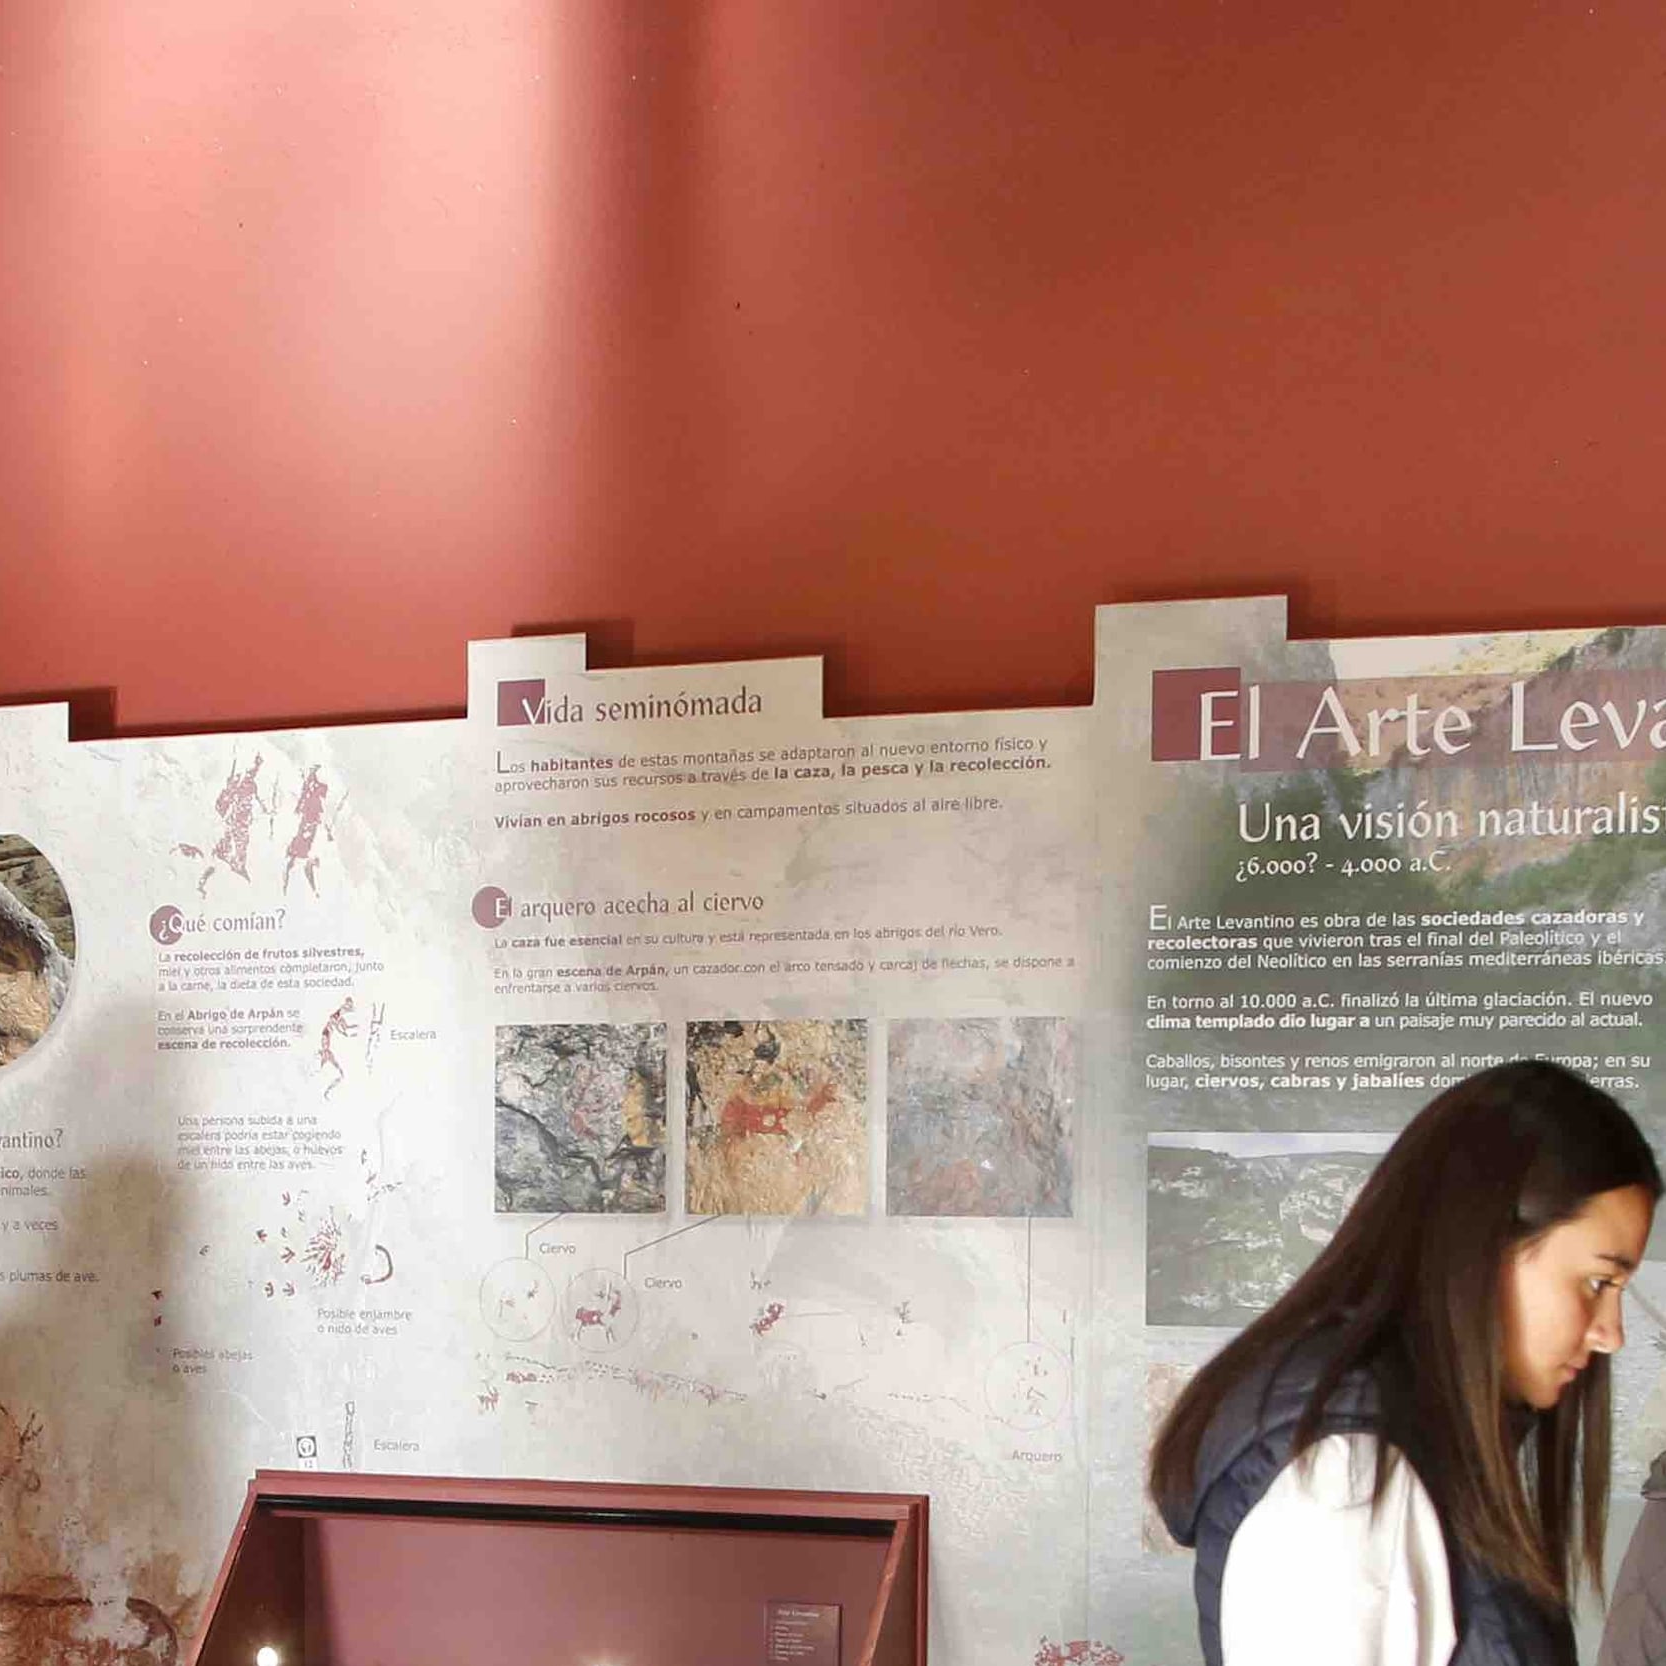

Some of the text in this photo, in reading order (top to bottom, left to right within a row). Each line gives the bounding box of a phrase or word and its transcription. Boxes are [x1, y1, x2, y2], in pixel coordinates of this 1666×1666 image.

[522, 685, 762, 726] Vida seminómada
[1199, 684, 1261, 761] El
[1295, 685, 1473, 759] Arte
[497, 735, 1047, 774] Los habitantes de estas montañas se adaptaron al nuevo entorno físico y
[495, 754, 1051, 794] aprovecharon sus recursos a través de la caza, la pesca y la recolección.
[494, 795, 1002, 829] Vivían en abrigos rocosos y en campamentos situados al aire libre.
[1239, 802, 1321, 843] Una
[1338, 799, 1459, 841] visión
[1235, 851, 1318, 883] ¿6.000?
[1341, 856, 1402, 878] 4.000
[1409, 851, 1452, 873] a.C.
[495, 890, 764, 923] El arquero acecha al ciervo
[1148, 905, 1643, 931] El Arte Levantino es obra de las sociedades cazadoras y
[159, 908, 286, 940] ¿Qué comían?
[1148, 929, 1620, 952] recolectoras que vivieron tras el final del Paleolítico y el
[1147, 952, 1221, 968] comienzo
[1227, 951, 1251, 968] del
[1257, 951, 1326, 968] Neolítico
[1332, 955, 1352, 967] en
[1358, 950, 1381, 967] las
[1387, 950, 1463, 967] serranías
[1469, 949, 1591, 966] mediterráneas
[1146, 1011, 1642, 1031] clima templado dio lugar a un paisaje muy parecido al actual.
[1146, 1072, 1188, 1091] lugar,
[1195, 1073, 1264, 1089] ciervos,
[1270, 1072, 1330, 1087] cabras
[1336, 1076, 1346, 1091] y
[1351, 1072, 1424, 1091] jabalíes
[539, 1241, 576, 1256] Ciervo
[644, 1276, 682, 1290] Ciervo
